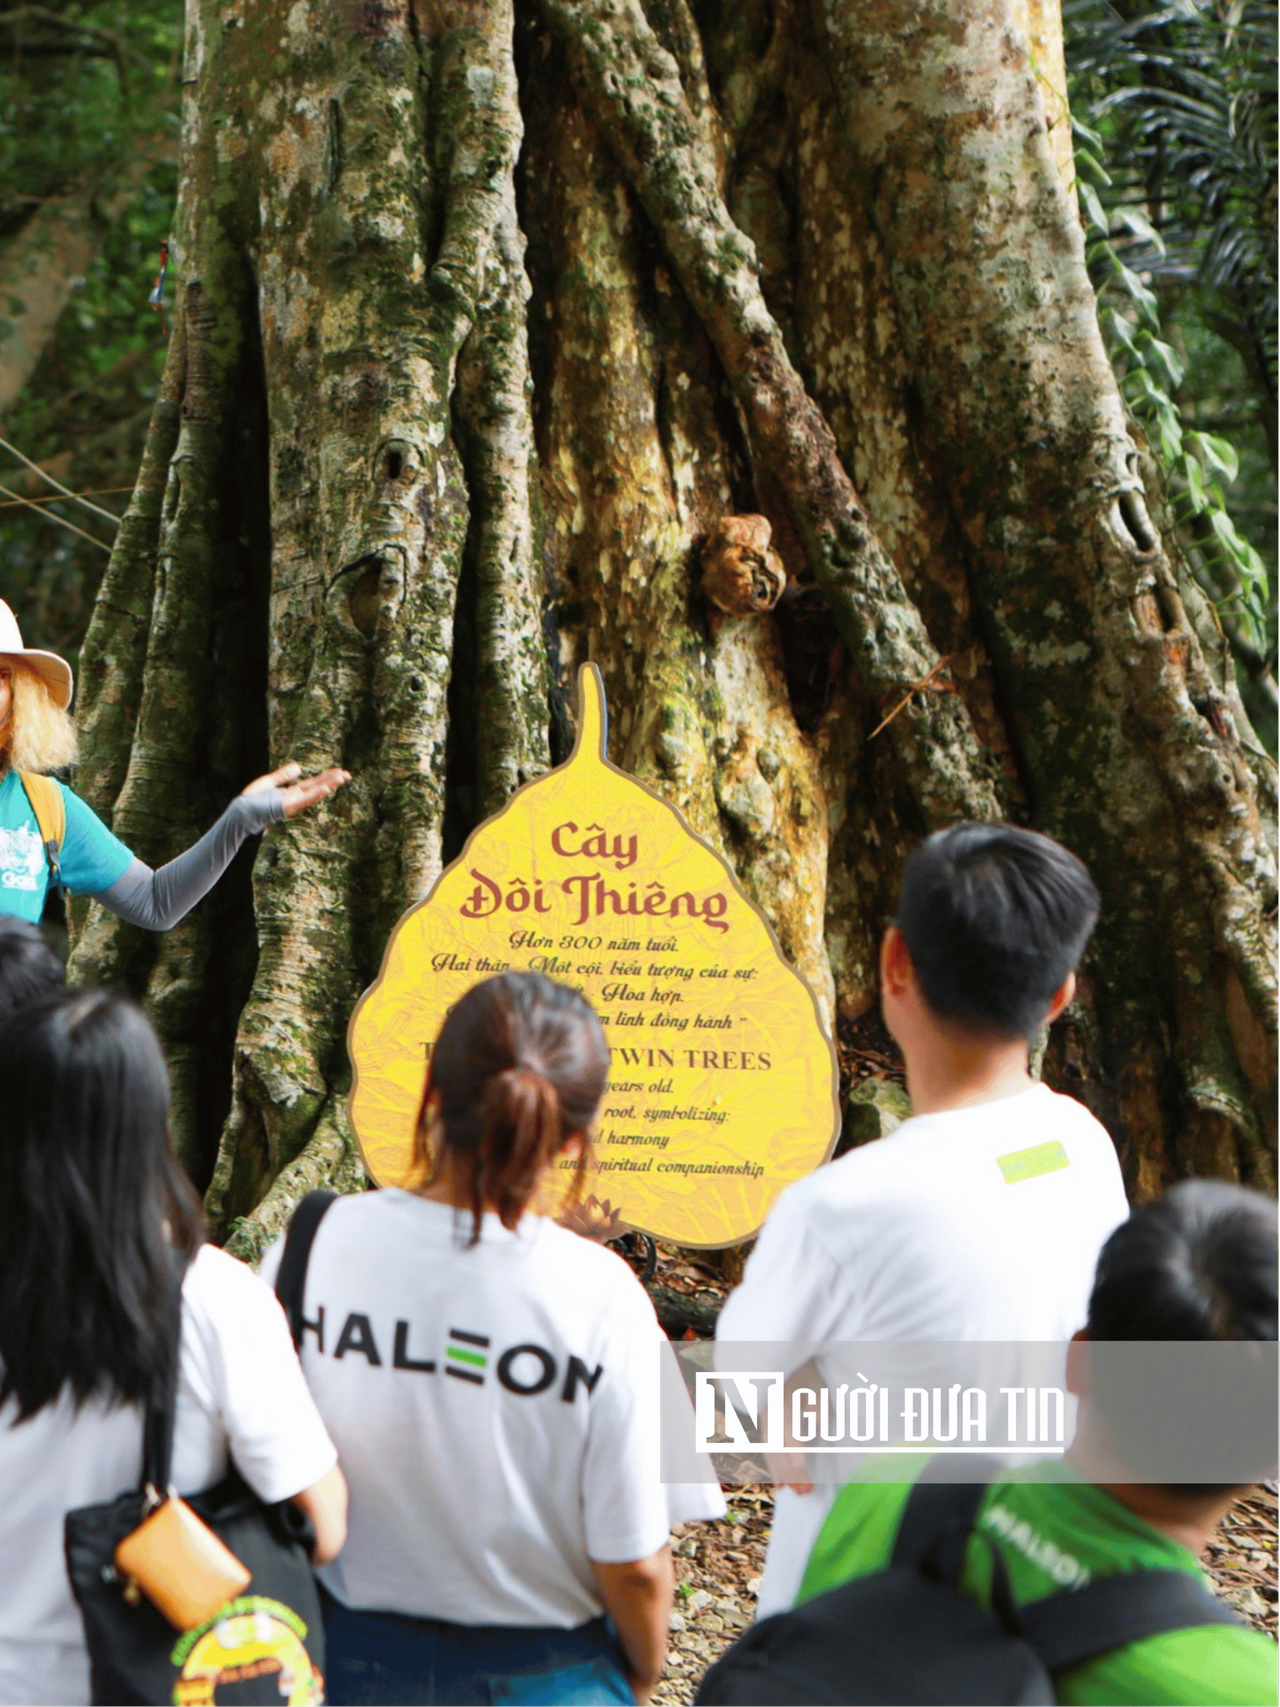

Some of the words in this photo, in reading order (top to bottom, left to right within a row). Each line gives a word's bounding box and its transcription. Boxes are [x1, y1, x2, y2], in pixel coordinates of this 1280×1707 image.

[551, 821, 638, 870] Cây
[460, 868, 552, 918] Đôi
[562, 872, 730, 934] Thiêng
[508, 930, 553, 950] Hơn
[559, 935, 602, 950] 300
[606, 937, 640, 951] năm
[431, 953, 470, 973] Hai
[610, 960, 642, 976] biểu
[647, 963, 694, 981] tượng
[699, 964, 728, 979] của
[601, 982, 646, 1002] Hòa
[615, 1011, 645, 1027] linh
[650, 1011, 689, 1032] đồng
[683, 1049, 772, 1071] TREES
[607, 1129, 670, 1149] harmony
[558, 1155, 588, 1170] an
[656, 1160, 765, 1179] companionship
[300, 1304, 604, 1405] HALEON
